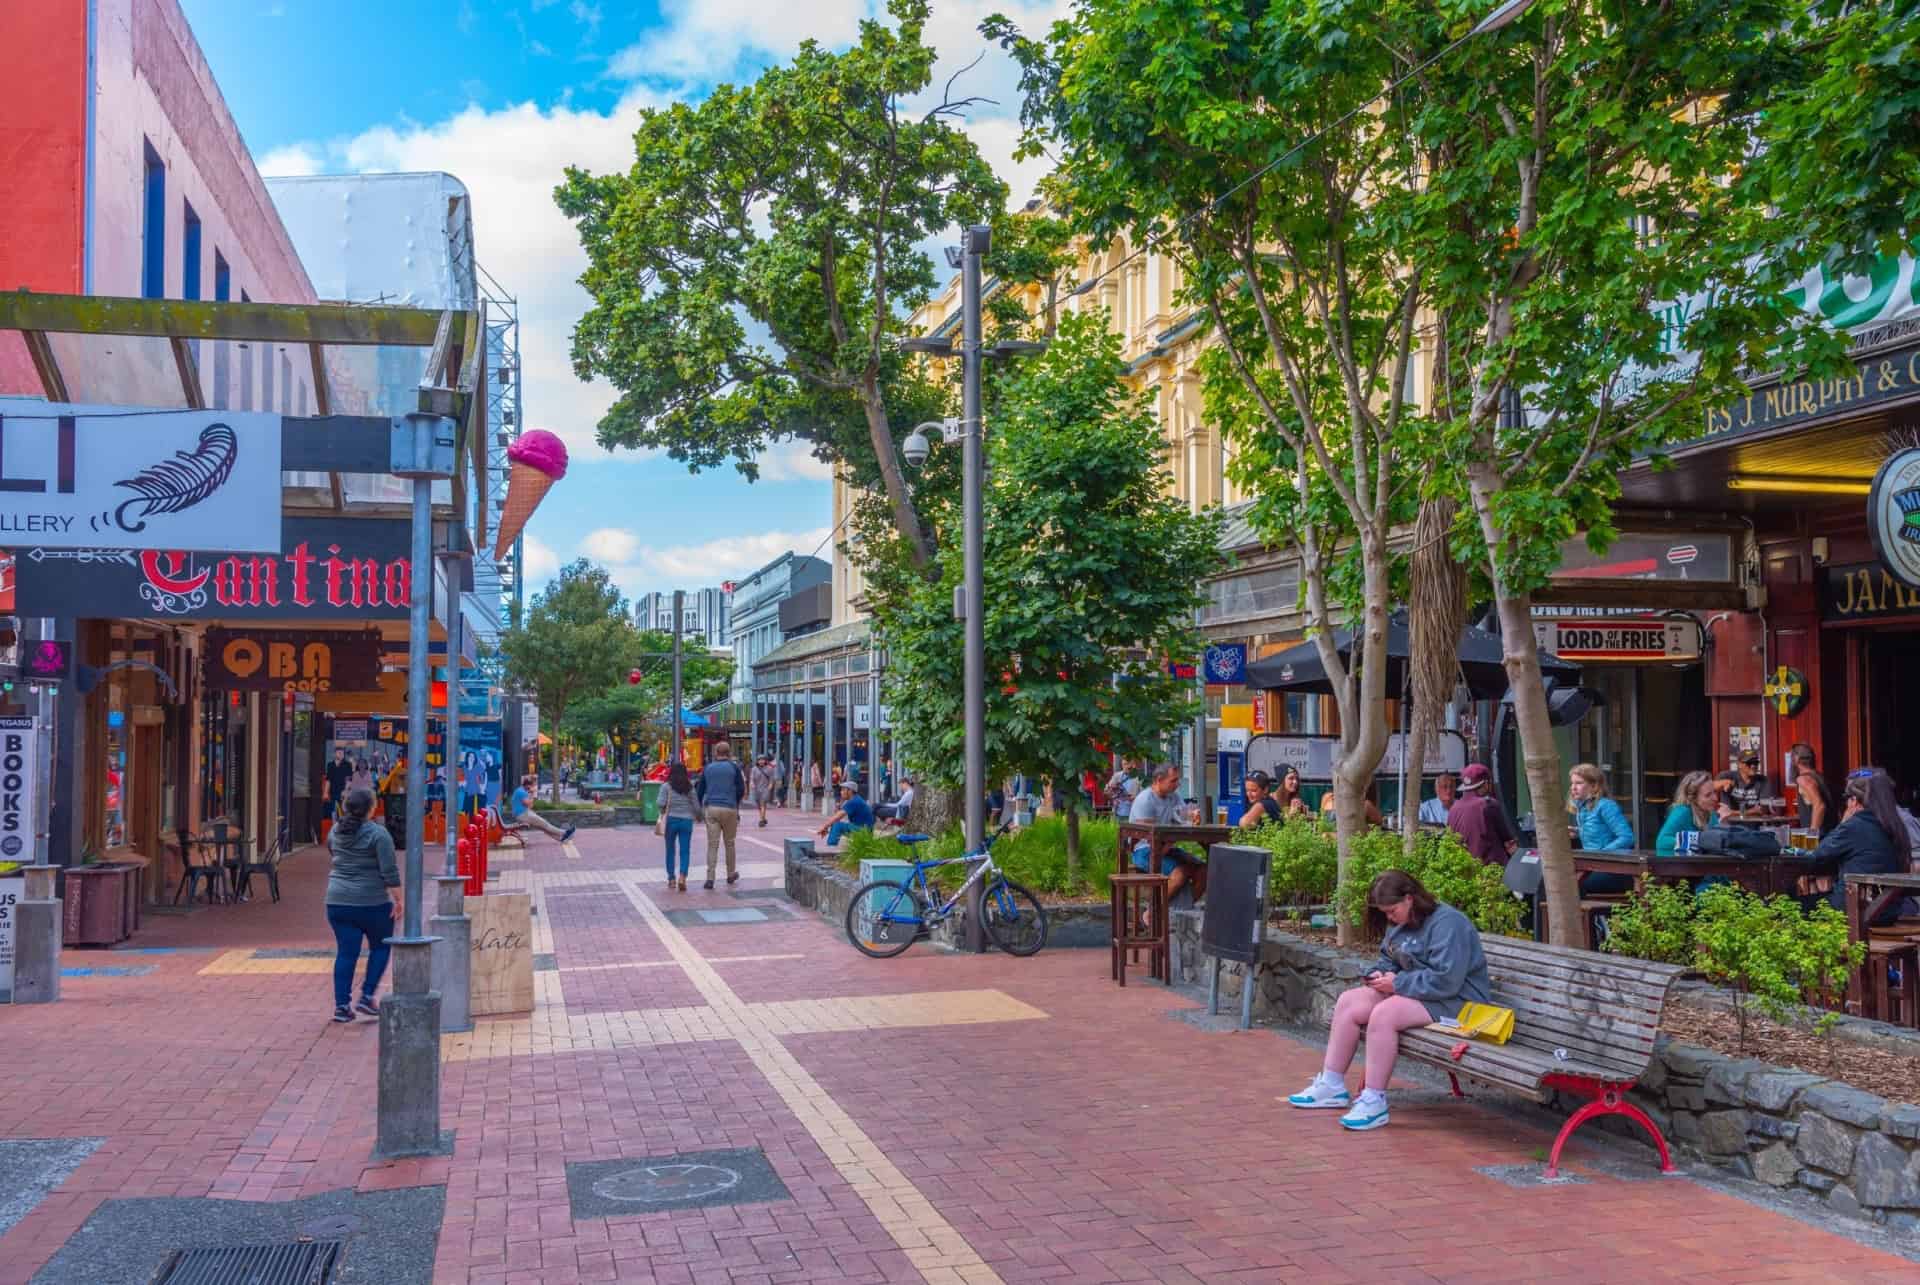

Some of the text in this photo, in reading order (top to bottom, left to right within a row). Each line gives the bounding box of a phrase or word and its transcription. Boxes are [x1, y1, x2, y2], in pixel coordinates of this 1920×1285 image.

[1877, 360, 1901, 391] &
[1557, 631, 1603, 649] LORD
[1607, 631, 1618, 639] OF
[1622, 631, 1666, 649] FRIES
[1605, 640, 1621, 649] THE
[3, 734, 22, 831] BOOKS
